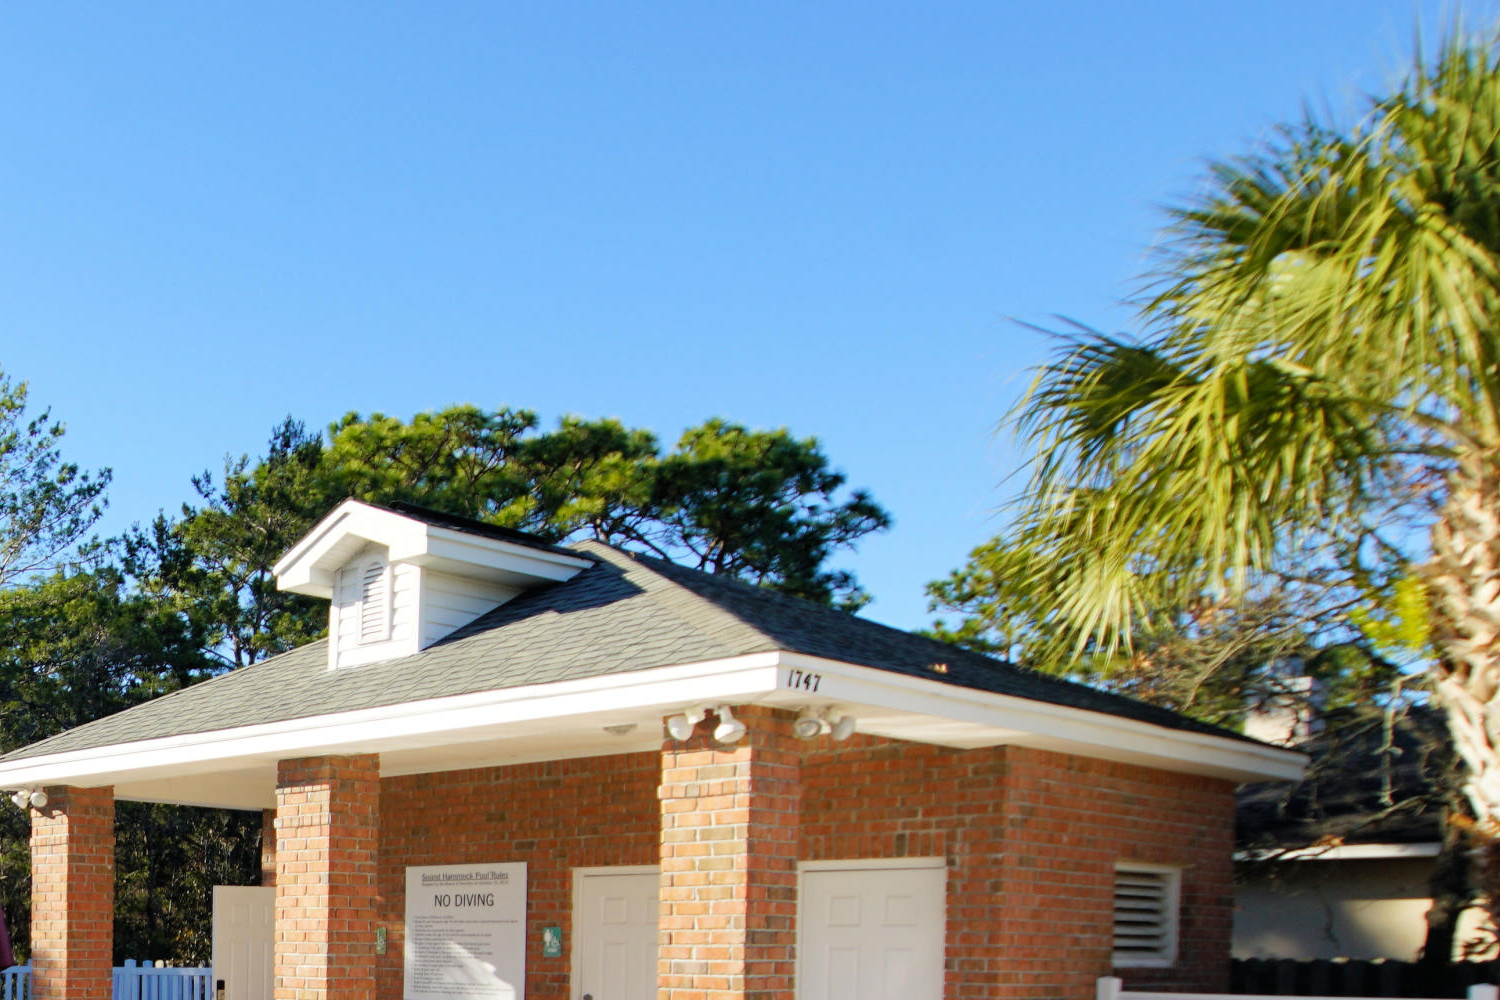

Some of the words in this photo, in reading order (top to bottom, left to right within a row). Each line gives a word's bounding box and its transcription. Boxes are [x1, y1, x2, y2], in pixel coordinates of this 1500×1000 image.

[788, 669, 822, 693] 1747
[421, 873, 441, 881] Sound
[442, 872, 473, 881] Hammock
[434, 894, 451, 907] NO
[455, 893, 495, 907] DIVING
